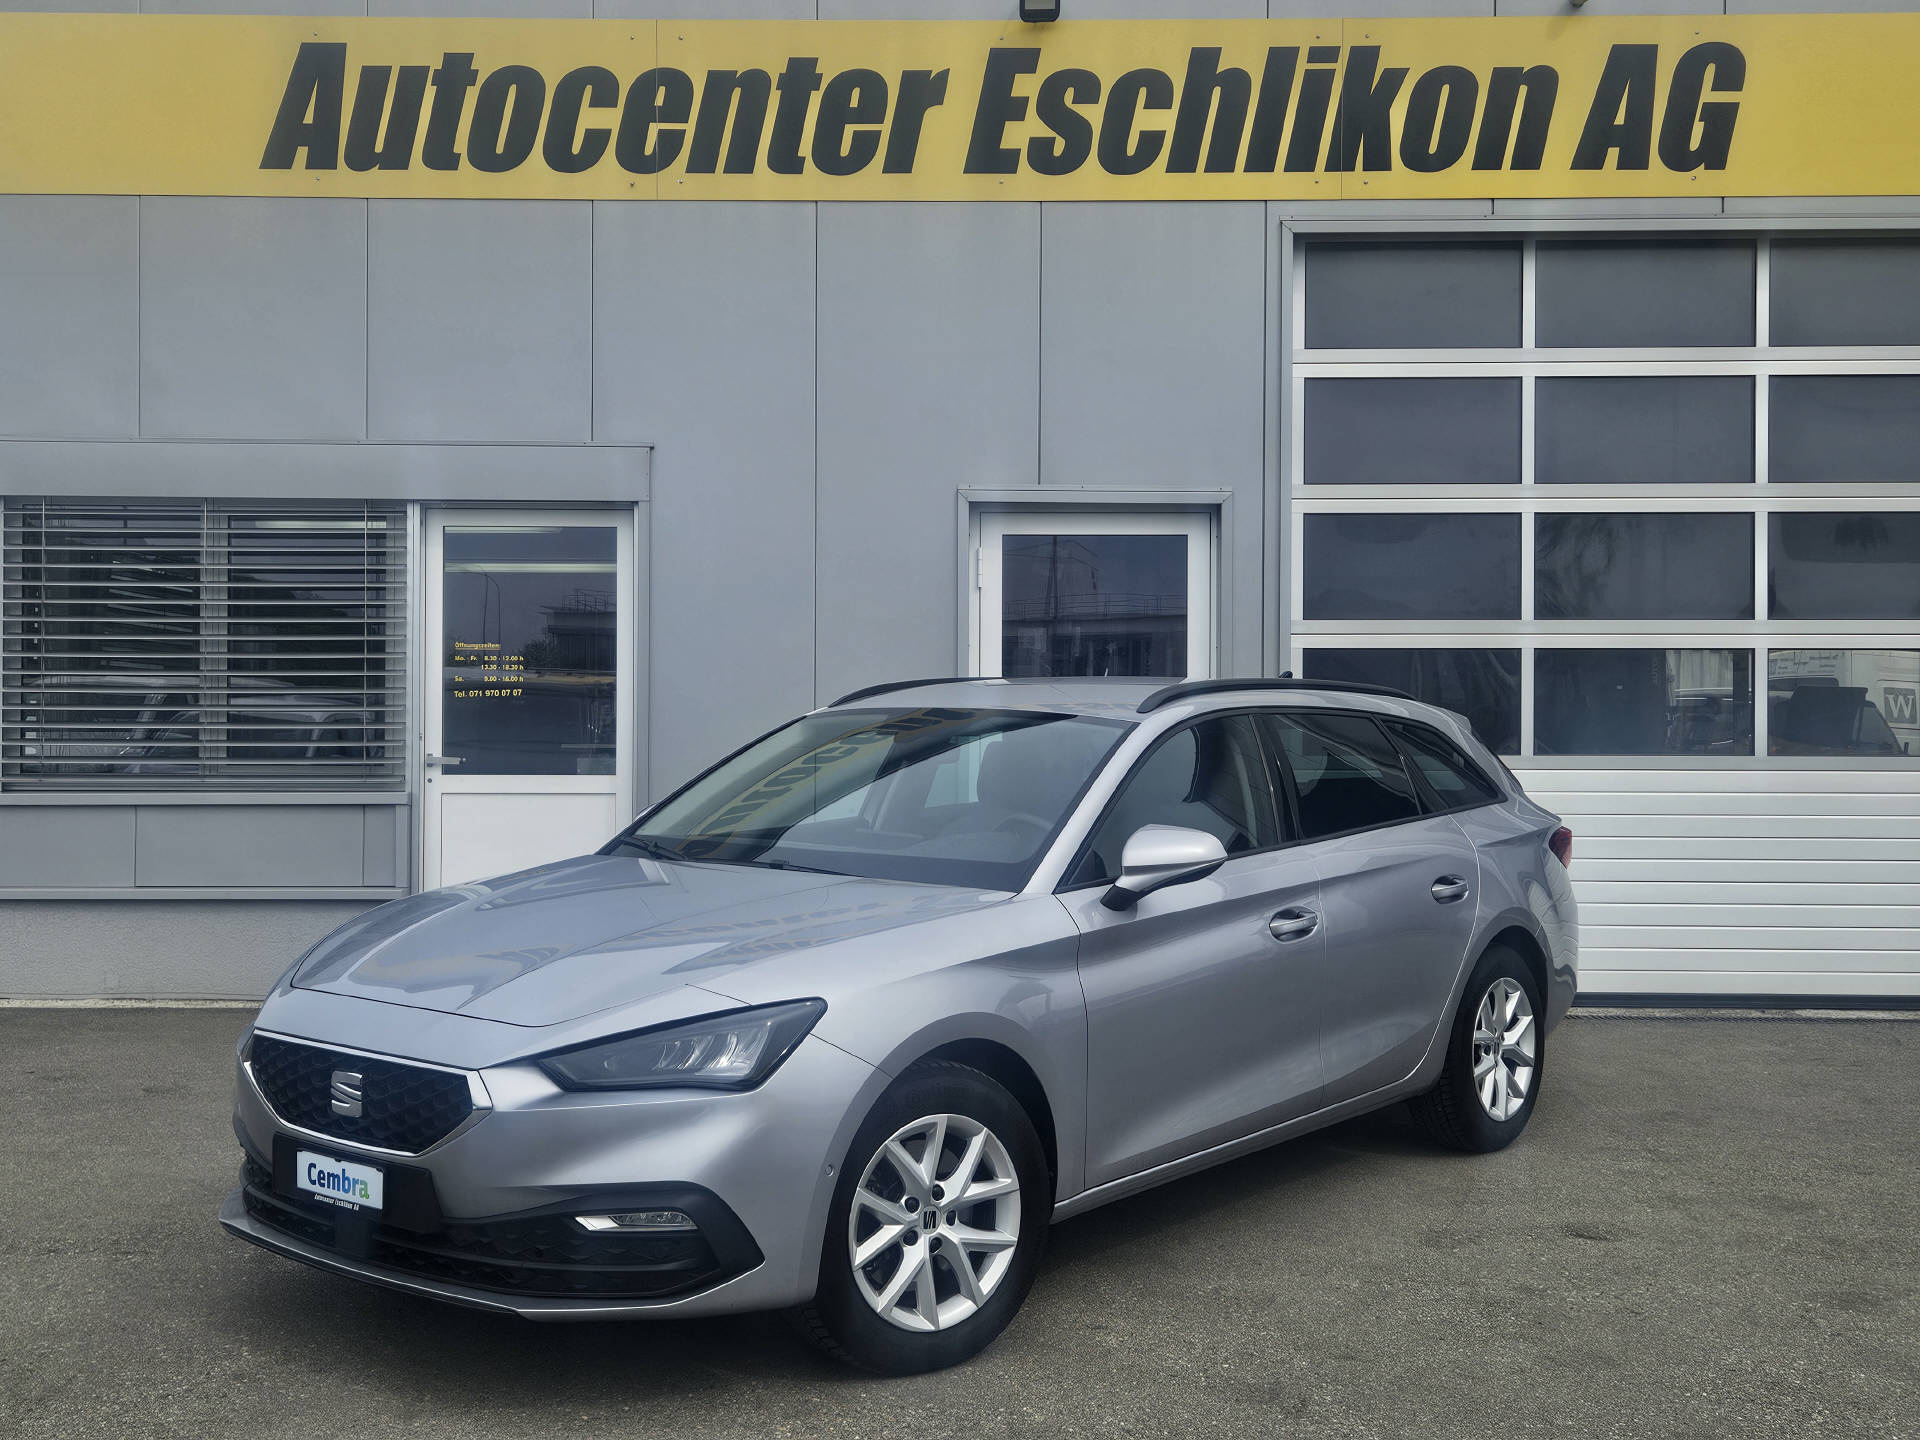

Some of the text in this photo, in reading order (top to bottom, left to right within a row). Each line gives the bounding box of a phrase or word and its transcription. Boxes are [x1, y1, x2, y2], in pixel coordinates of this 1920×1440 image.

[259, 40, 1747, 177] Autocenter Eschlikon AG
[453, 690, 467, 698] Tel.
[469, 690, 483, 698] 071
[501, 689, 511, 697] 07
[512, 688, 522, 696] 07
[1885, 694, 1914, 719] W
[307, 1162, 370, 1199] Cembra
